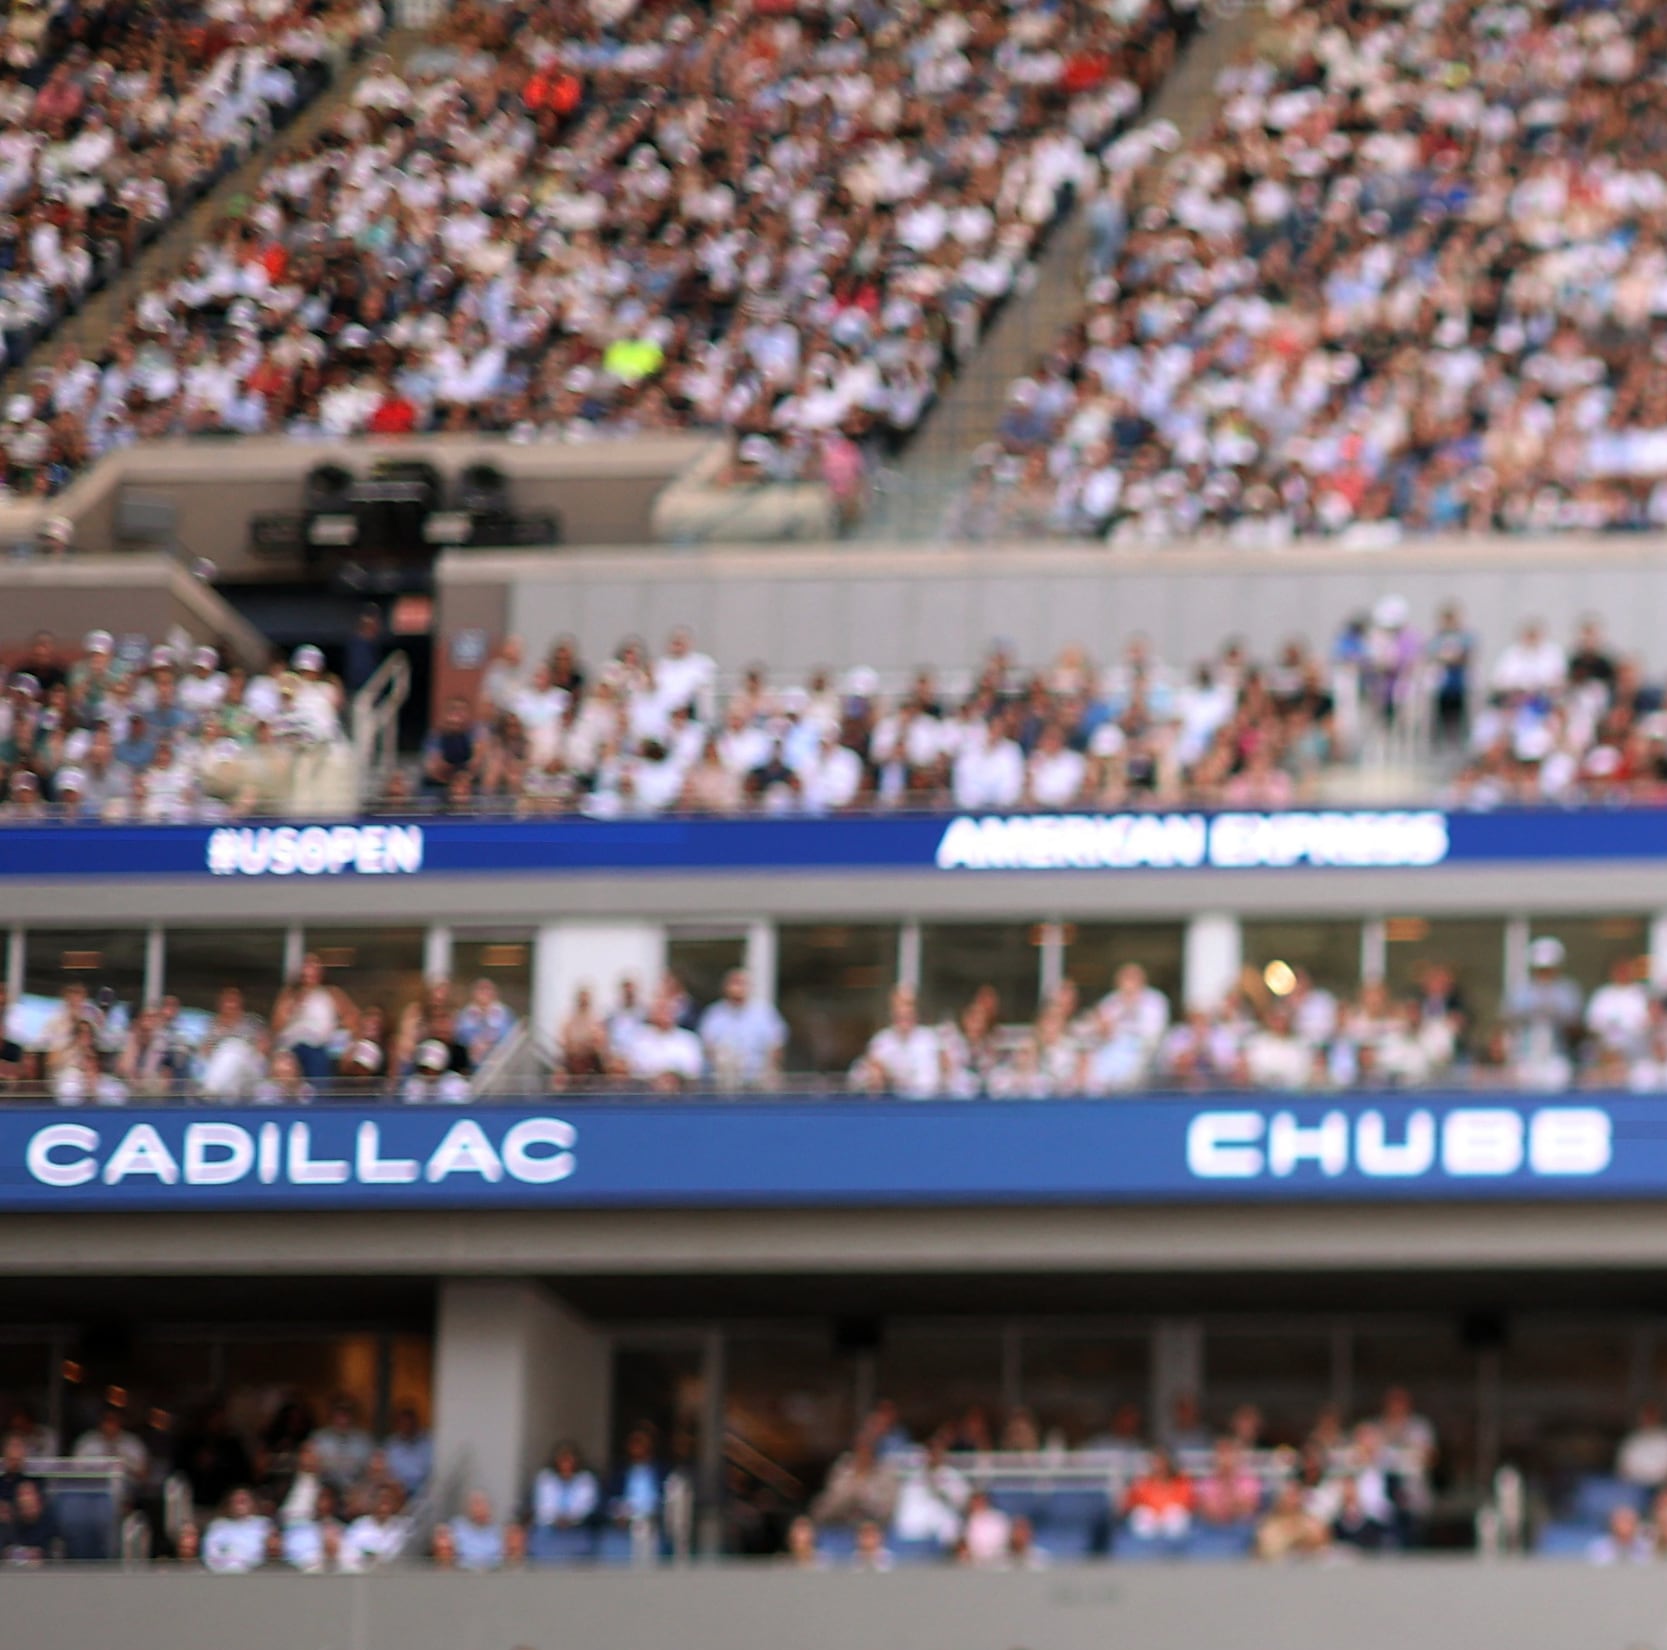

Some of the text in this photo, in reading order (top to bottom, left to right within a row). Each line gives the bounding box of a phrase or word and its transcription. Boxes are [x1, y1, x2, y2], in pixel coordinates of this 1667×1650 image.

[207, 825, 423, 875] #USOPEN
[937, 812, 1449, 868] AMERICAN EXPRESS
[27, 1117, 576, 1187] CADILLAC
[1187, 1108, 1613, 1177] CHUBB
